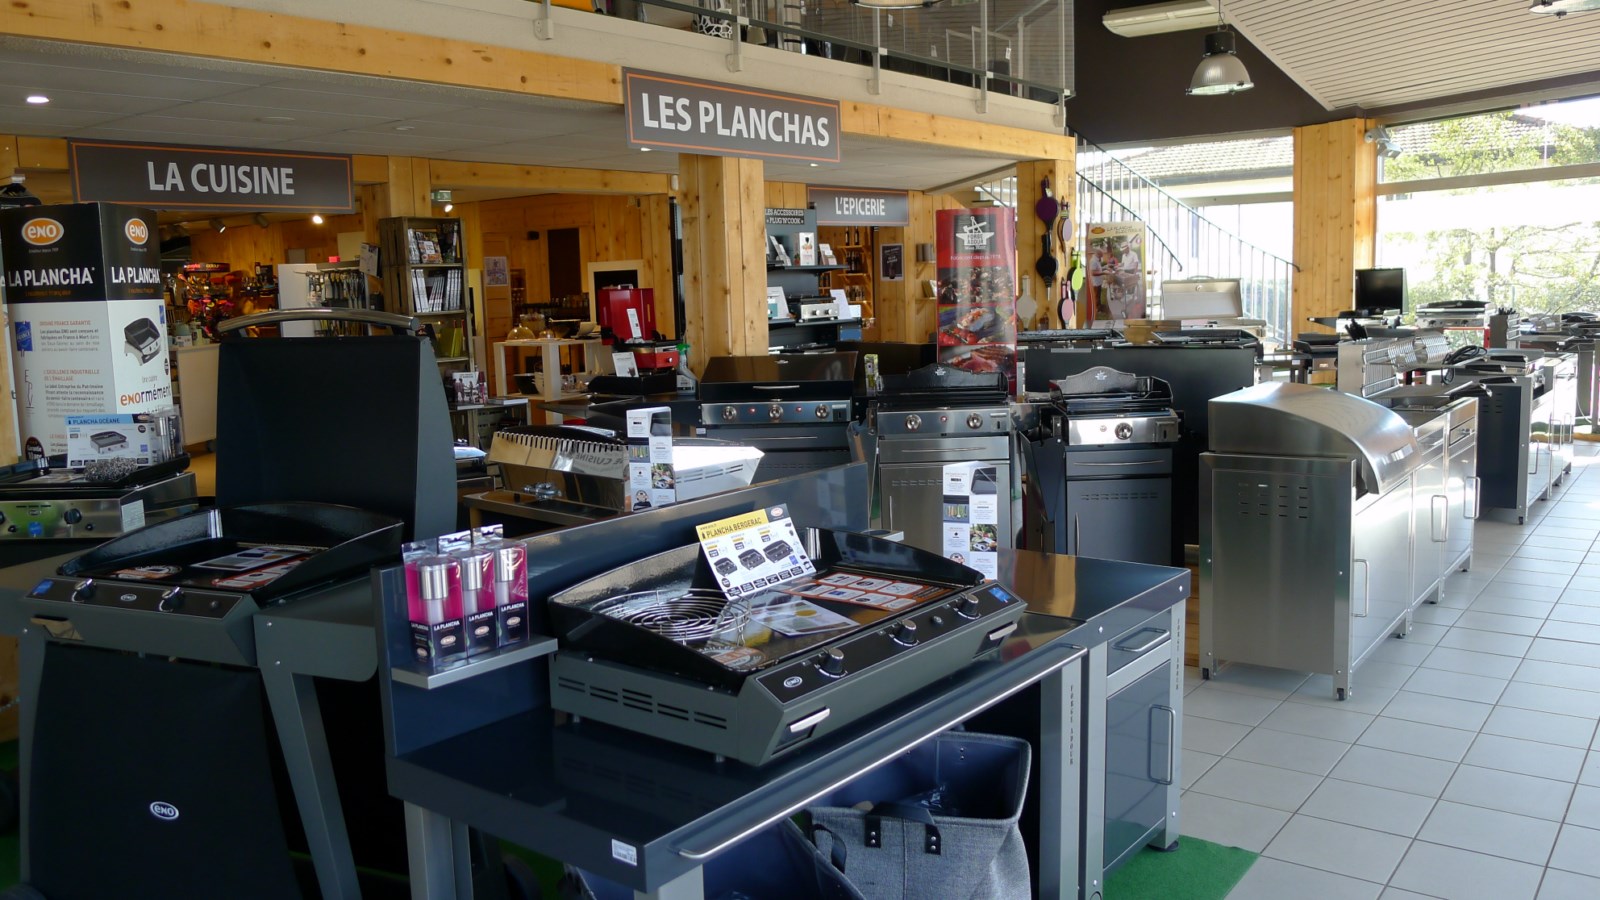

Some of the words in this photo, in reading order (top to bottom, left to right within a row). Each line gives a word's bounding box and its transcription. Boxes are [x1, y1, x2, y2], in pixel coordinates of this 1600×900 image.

[642, 92, 692, 132] LES
[699, 101, 830, 147] PLANCHAS
[147, 161, 184, 191] LA
[191, 163, 295, 196] CUISINE
[835, 196, 886, 216] L'EPICERIE
[8, 270, 22, 287] LA
[111, 266, 126, 284] LA
[706, 524, 734, 540] PLANCHA
